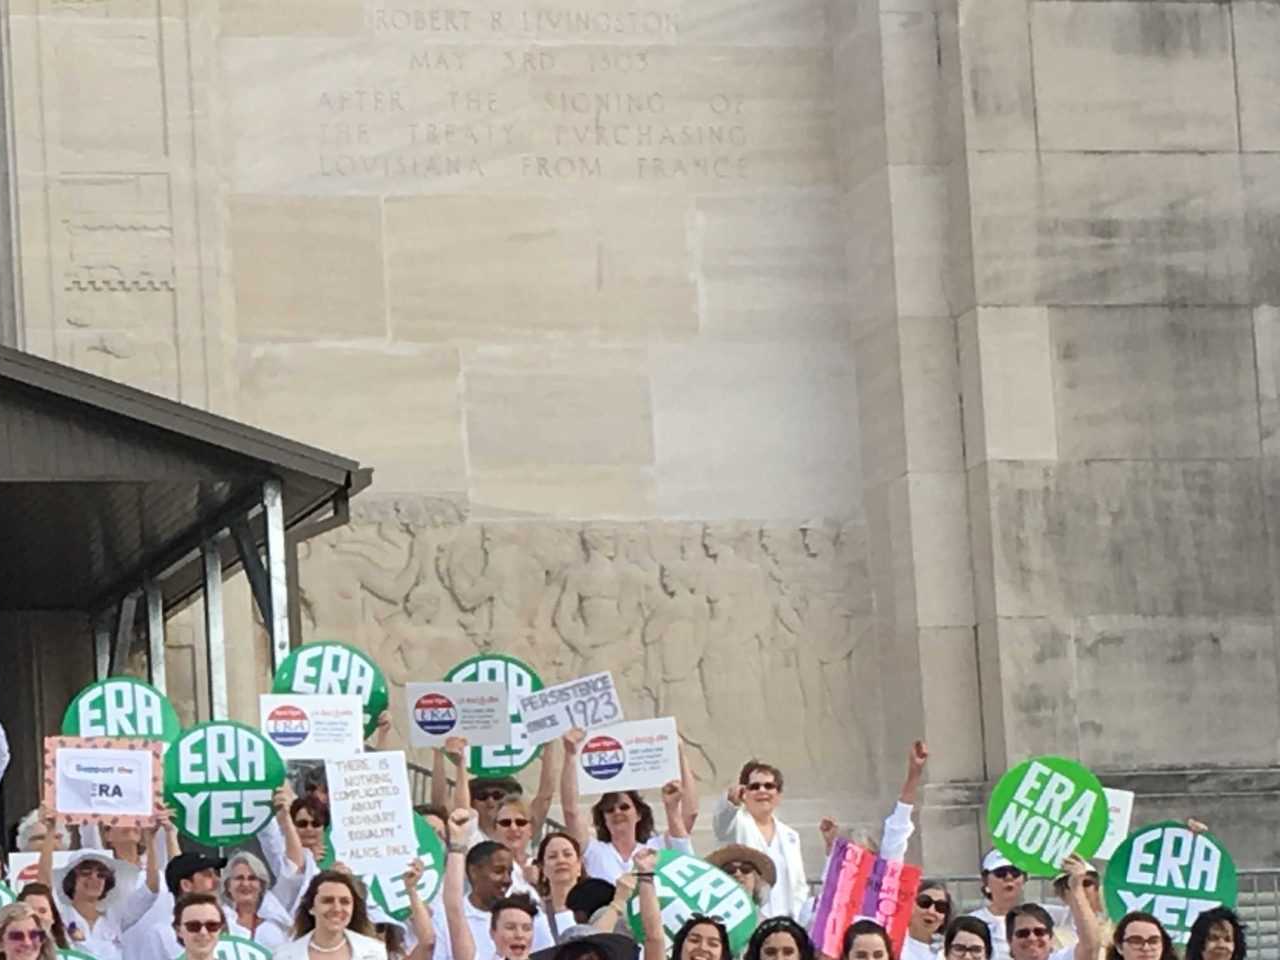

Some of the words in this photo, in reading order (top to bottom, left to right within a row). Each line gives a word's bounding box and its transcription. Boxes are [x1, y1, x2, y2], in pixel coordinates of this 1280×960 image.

[292, 645, 374, 706] ERA
[522, 675, 612, 712] PERSISTENCE
[78, 681, 163, 737] ERA
[566, 692, 618, 728] 1923
[179, 725, 265, 784] ERA
[173, 789, 273, 837] YES
[1014, 761, 1098, 835] ERA
[993, 802, 1081, 870] NOW
[1126, 827, 1221, 892] ERA
[660, 855, 753, 931] ERA
